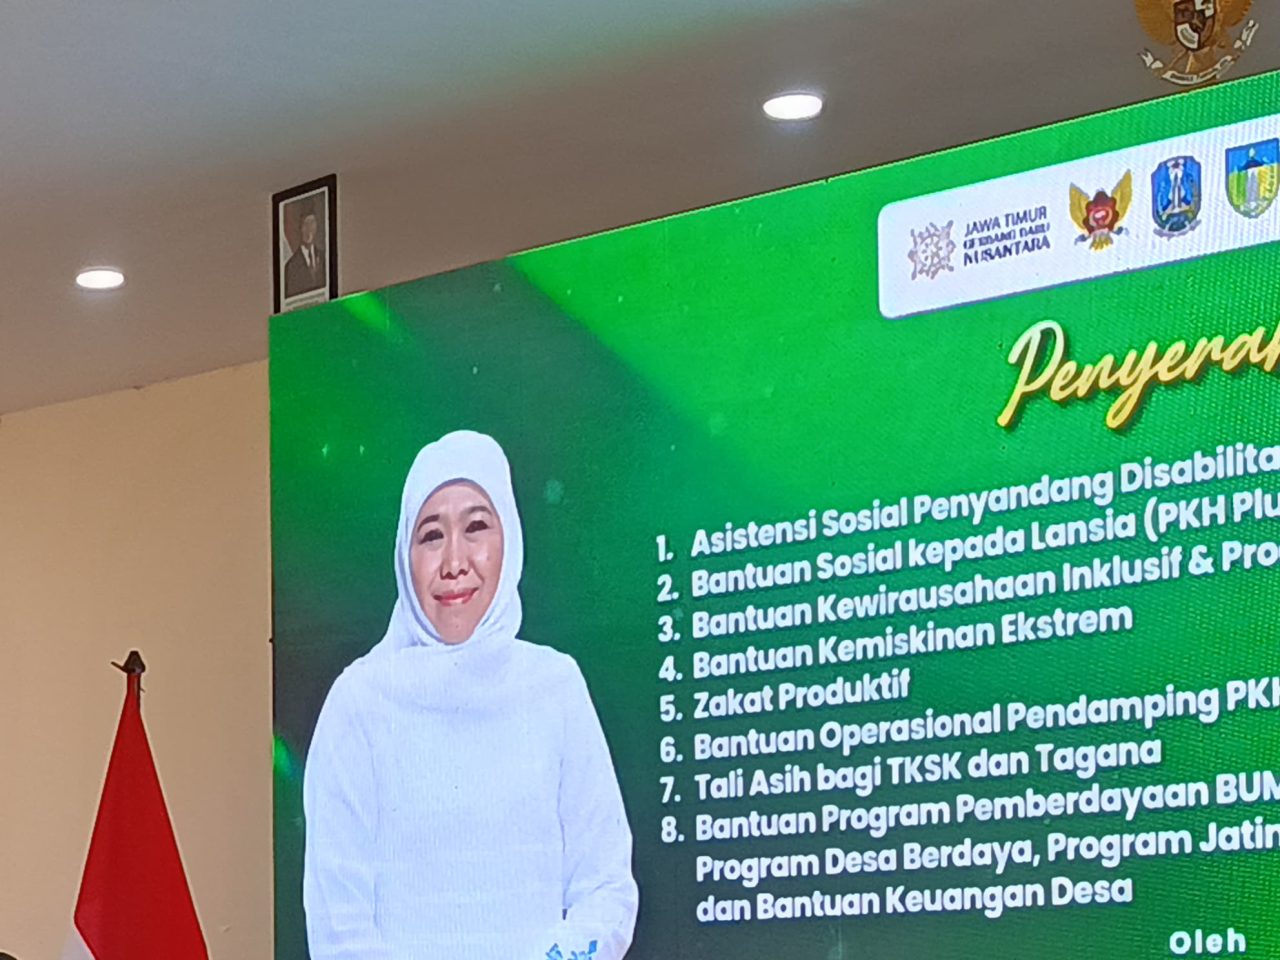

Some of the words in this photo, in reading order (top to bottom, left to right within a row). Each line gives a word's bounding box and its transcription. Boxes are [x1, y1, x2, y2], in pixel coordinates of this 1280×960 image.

[964, 216, 1001, 238] JAWA
[1005, 205, 1047, 228] TIMUR
[656, 535, 673, 562] 1.
[691, 509, 817, 557] Asistensi
[822, 497, 908, 537] Sosial
[913, 471, 1114, 525] Penyandang
[657, 574, 679, 602] 2.
[691, 560, 812, 597] Bantuan
[816, 541, 903, 579] Sosial
[908, 526, 1025, 572] kepada
[1031, 508, 1136, 550] Lansia
[1144, 495, 1226, 542] (PKH
[658, 615, 681, 642] 3.
[692, 603, 812, 638] Bantuan
[817, 571, 1056, 623] Kewirausahaan
[1063, 546, 1182, 592] Inklusif
[1188, 545, 1214, 575] &
[1222, 541, 1280, 572] Pro
[658, 655, 683, 682] 4.
[693, 644, 813, 679] Bantuan
[818, 621, 995, 664] Kemiskinan
[1001, 606, 1133, 644] Ekstrem
[660, 694, 683, 722] 5.
[693, 685, 774, 719] Zakat
[778, 668, 911, 710] Produktif
[660, 736, 683, 763] 6.
[694, 728, 815, 760] Bantuan
[819, 703, 1001, 756] Operasional
[1007, 684, 1220, 731] Pendamping
[659, 776, 681, 803] 7.
[694, 768, 744, 800] Tali
[749, 764, 812, 796] Asih
[816, 755, 882, 797] bagi
[886, 751, 962, 785] TKSK
[967, 748, 1029, 778] dan
[1034, 739, 1162, 779] Tagana
[661, 815, 685, 843] 8.
[696, 810, 817, 841] Bantuan
[821, 801, 951, 838] Program
[956, 781, 1209, 823] Pemberdayaan
[696, 854, 820, 888] Program
[825, 847, 897, 875] Desa
[903, 837, 1041, 875] Berdaya,
[1047, 830, 1193, 868] Program
[696, 895, 751, 922] dan
[756, 890, 880, 920] Bantuan
[885, 883, 1045, 919] Keuangan
[1051, 876, 1133, 906] Desa
[1168, 927, 1248, 955] Oleh
